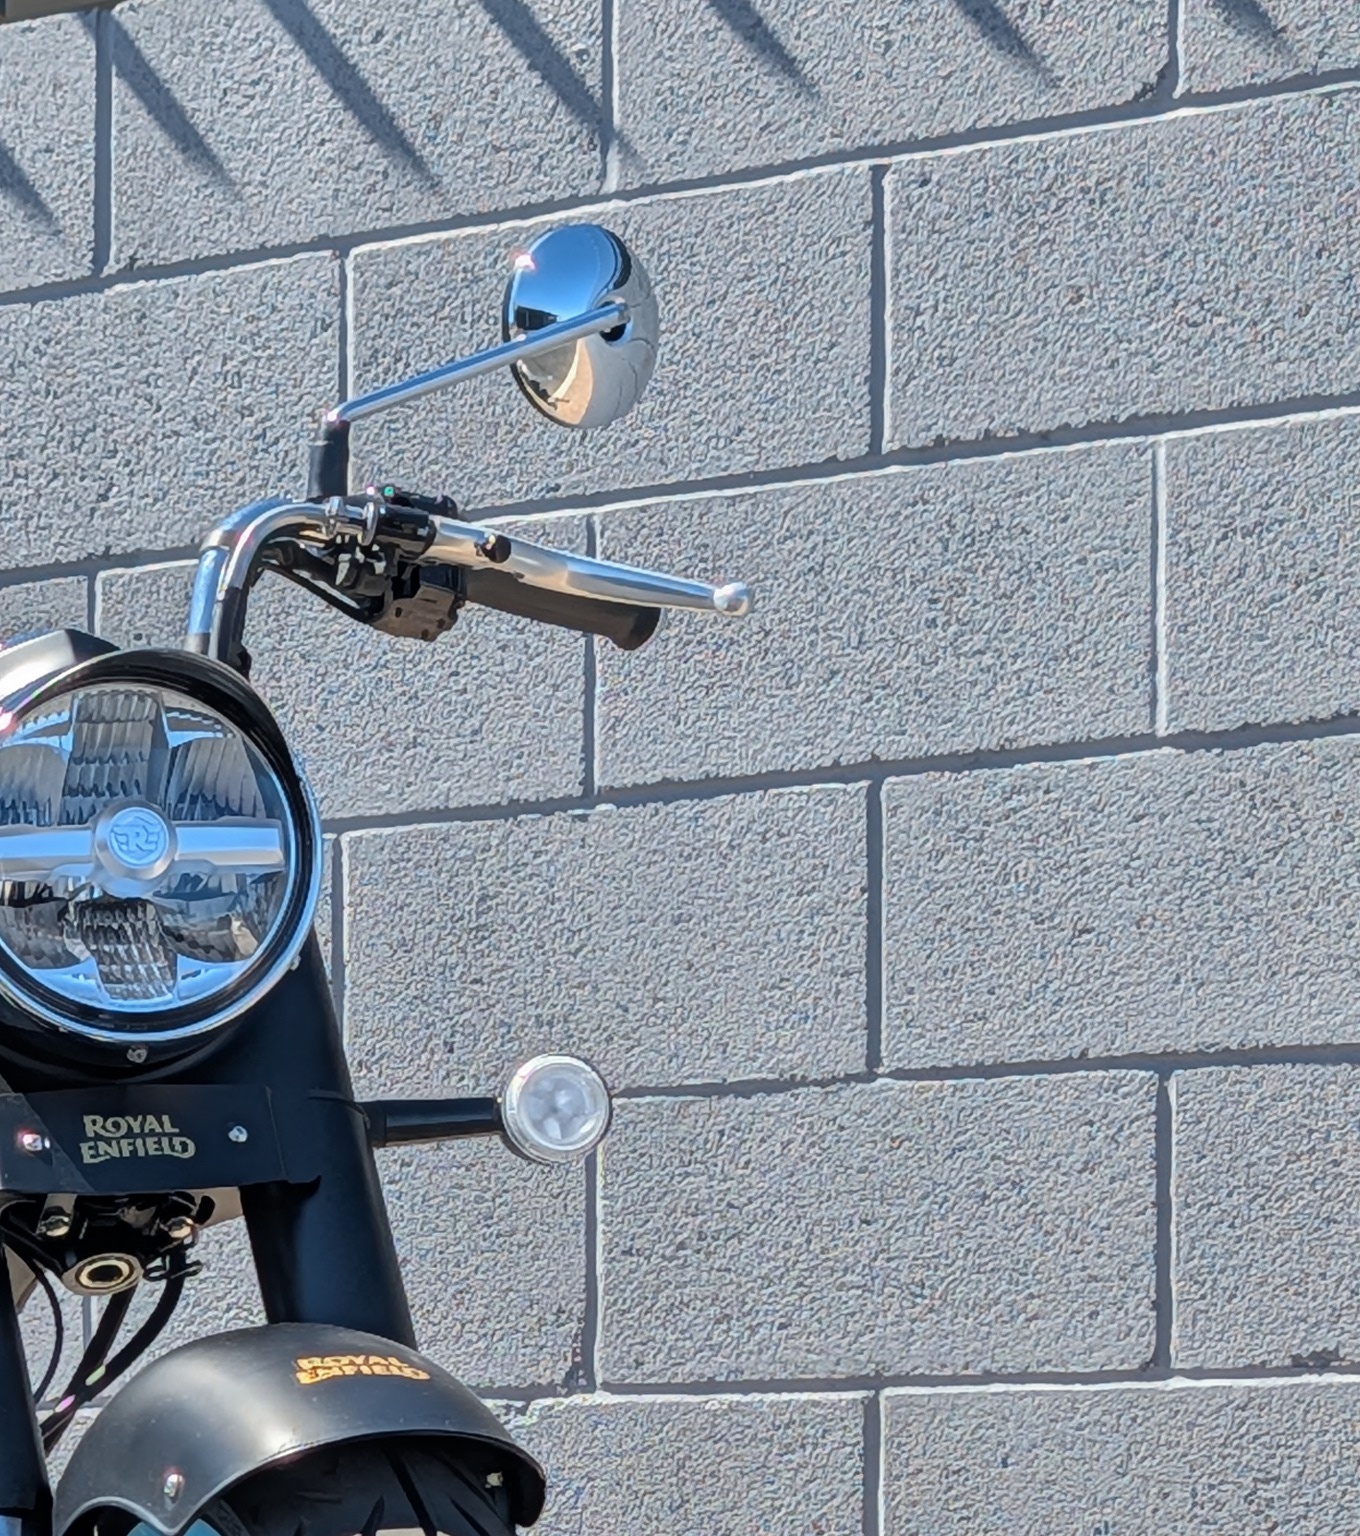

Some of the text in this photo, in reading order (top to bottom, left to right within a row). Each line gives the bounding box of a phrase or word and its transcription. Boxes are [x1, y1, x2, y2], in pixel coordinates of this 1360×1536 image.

[83, 1115, 179, 1137] ROYAL
[79, 1136, 196, 1163] ENFIELD
[295, 1354, 410, 1369] ROYAL
